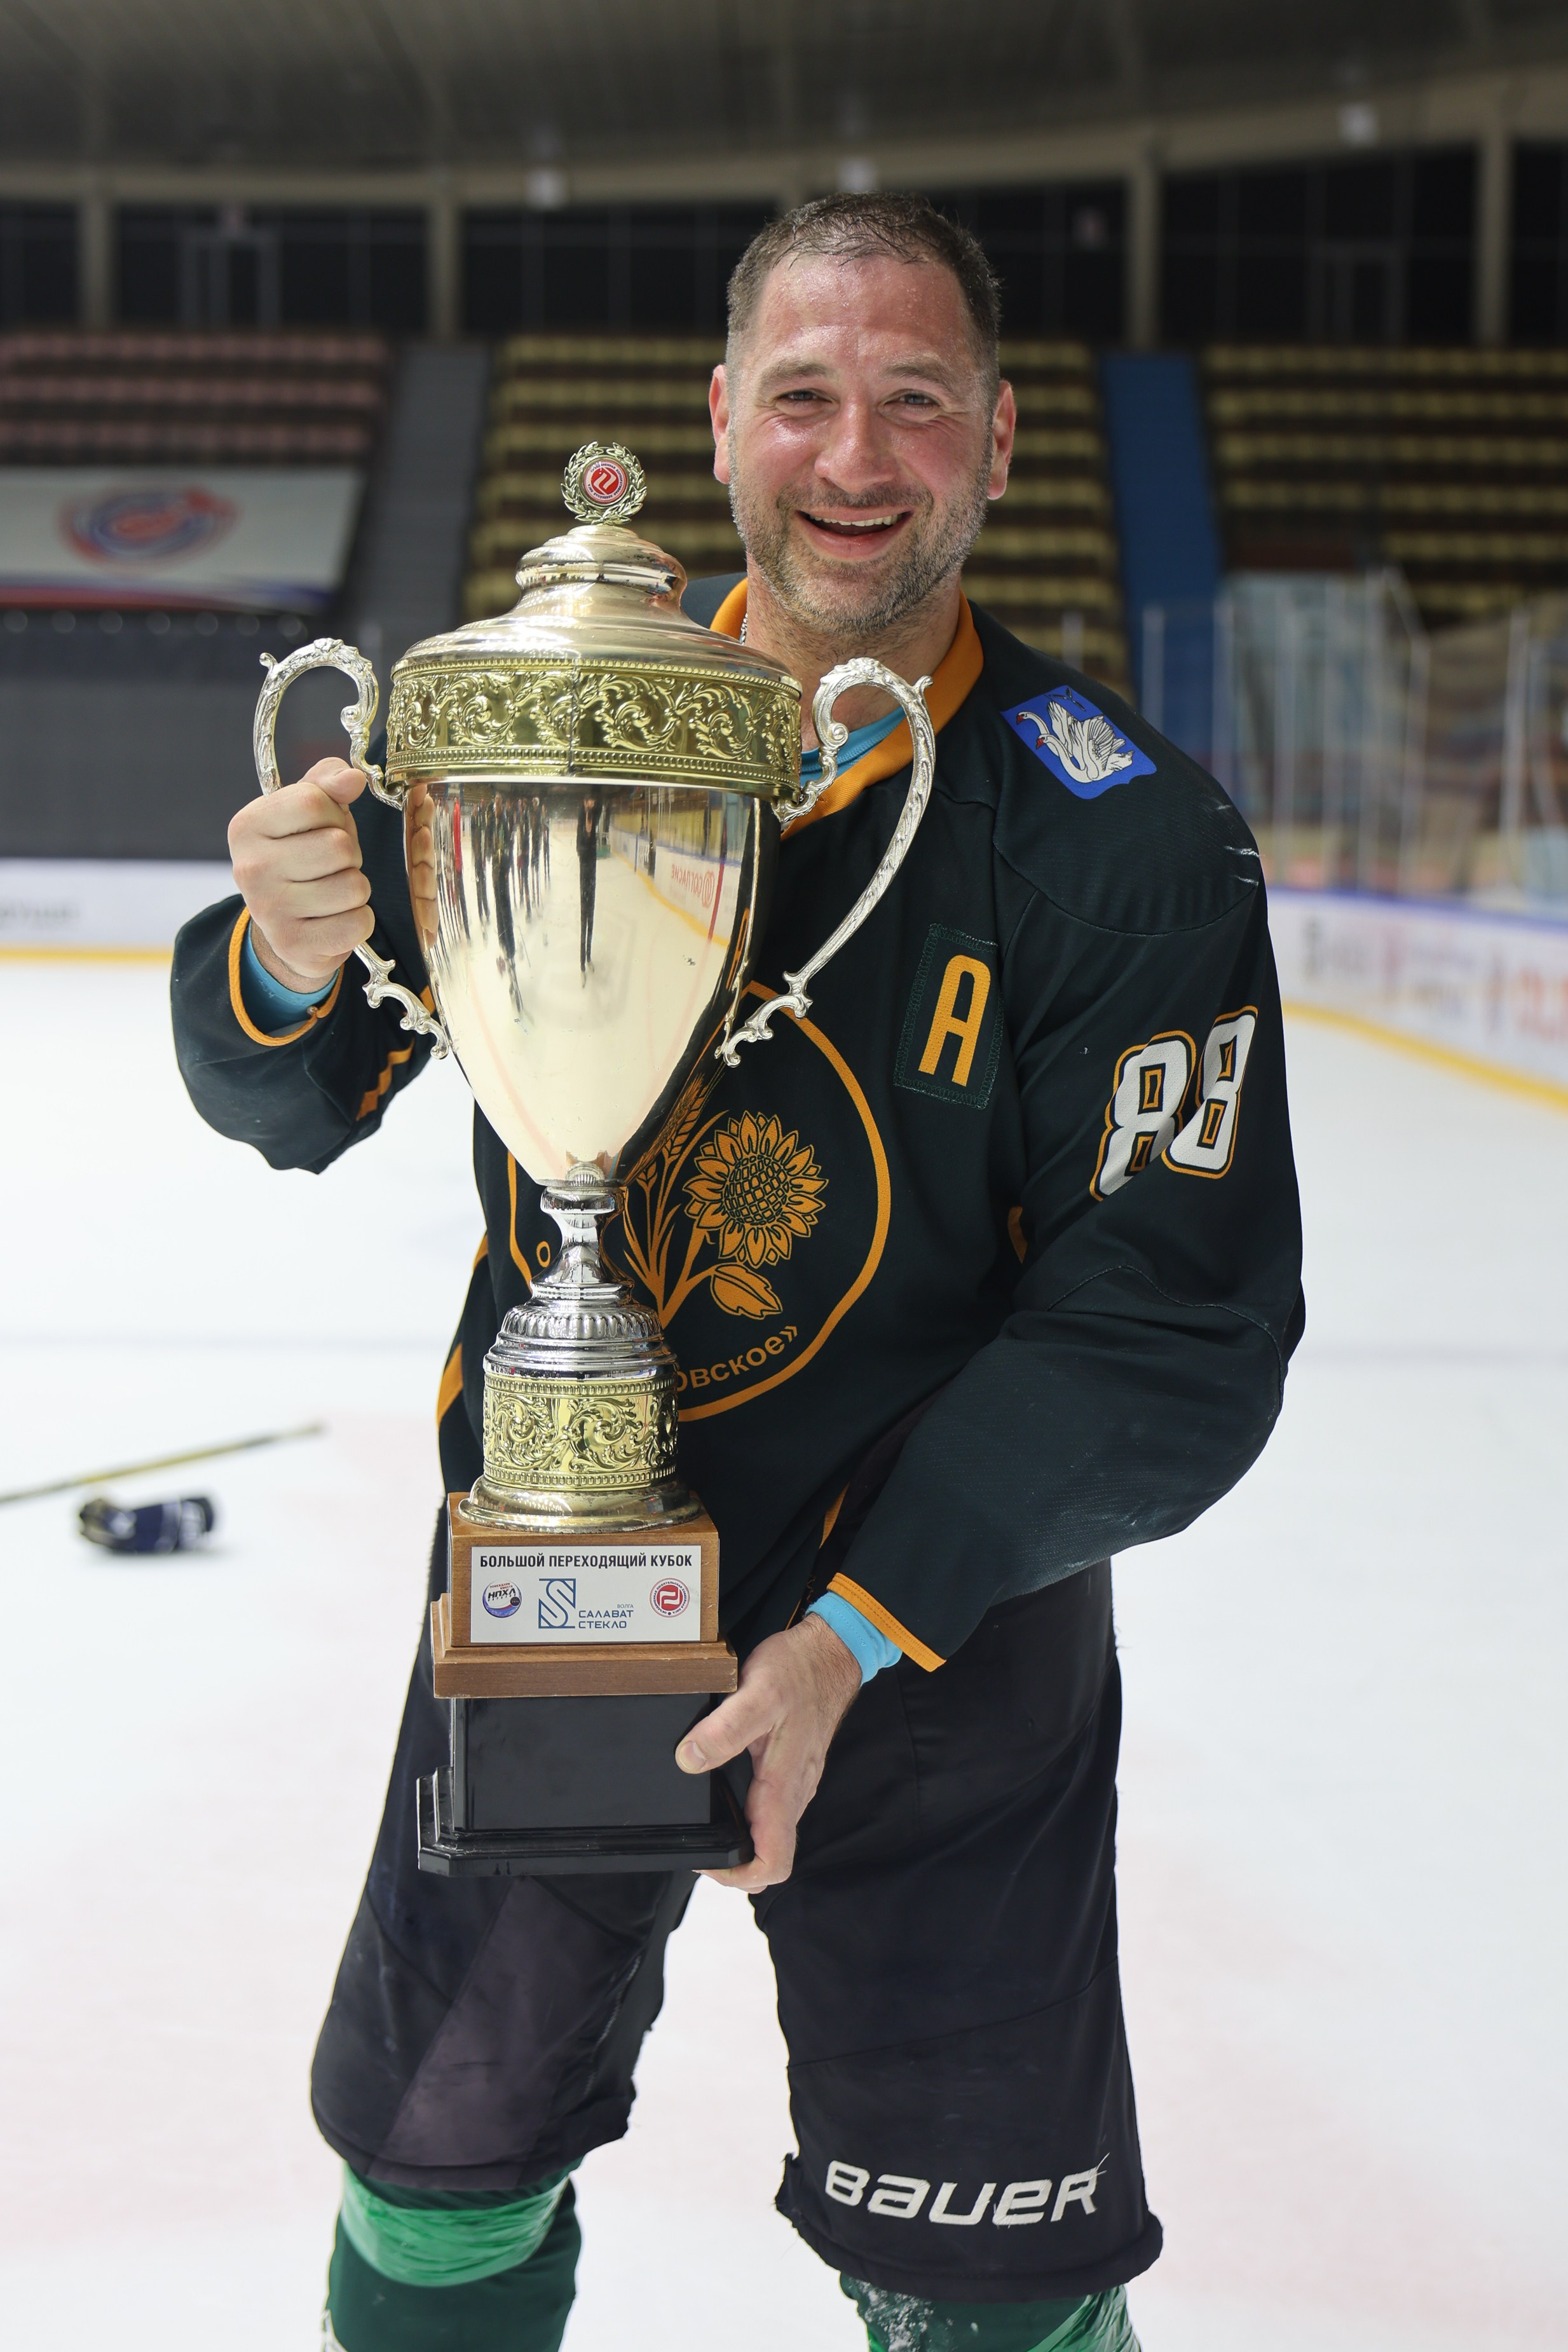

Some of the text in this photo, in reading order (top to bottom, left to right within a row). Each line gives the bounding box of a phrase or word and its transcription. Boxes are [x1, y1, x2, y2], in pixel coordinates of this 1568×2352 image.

[1090, 1006, 1258, 1201] 88
[481, 1552, 692, 1568] БОЛЬШОЙ ПЕРЕХОДЯЩИЙ КУБОК
[488, 1588, 516, 1599] НПХЛ
[578, 1610, 634, 1618] САЛАВАТ
[578, 1620, 627, 1629] СТЕКЛО
